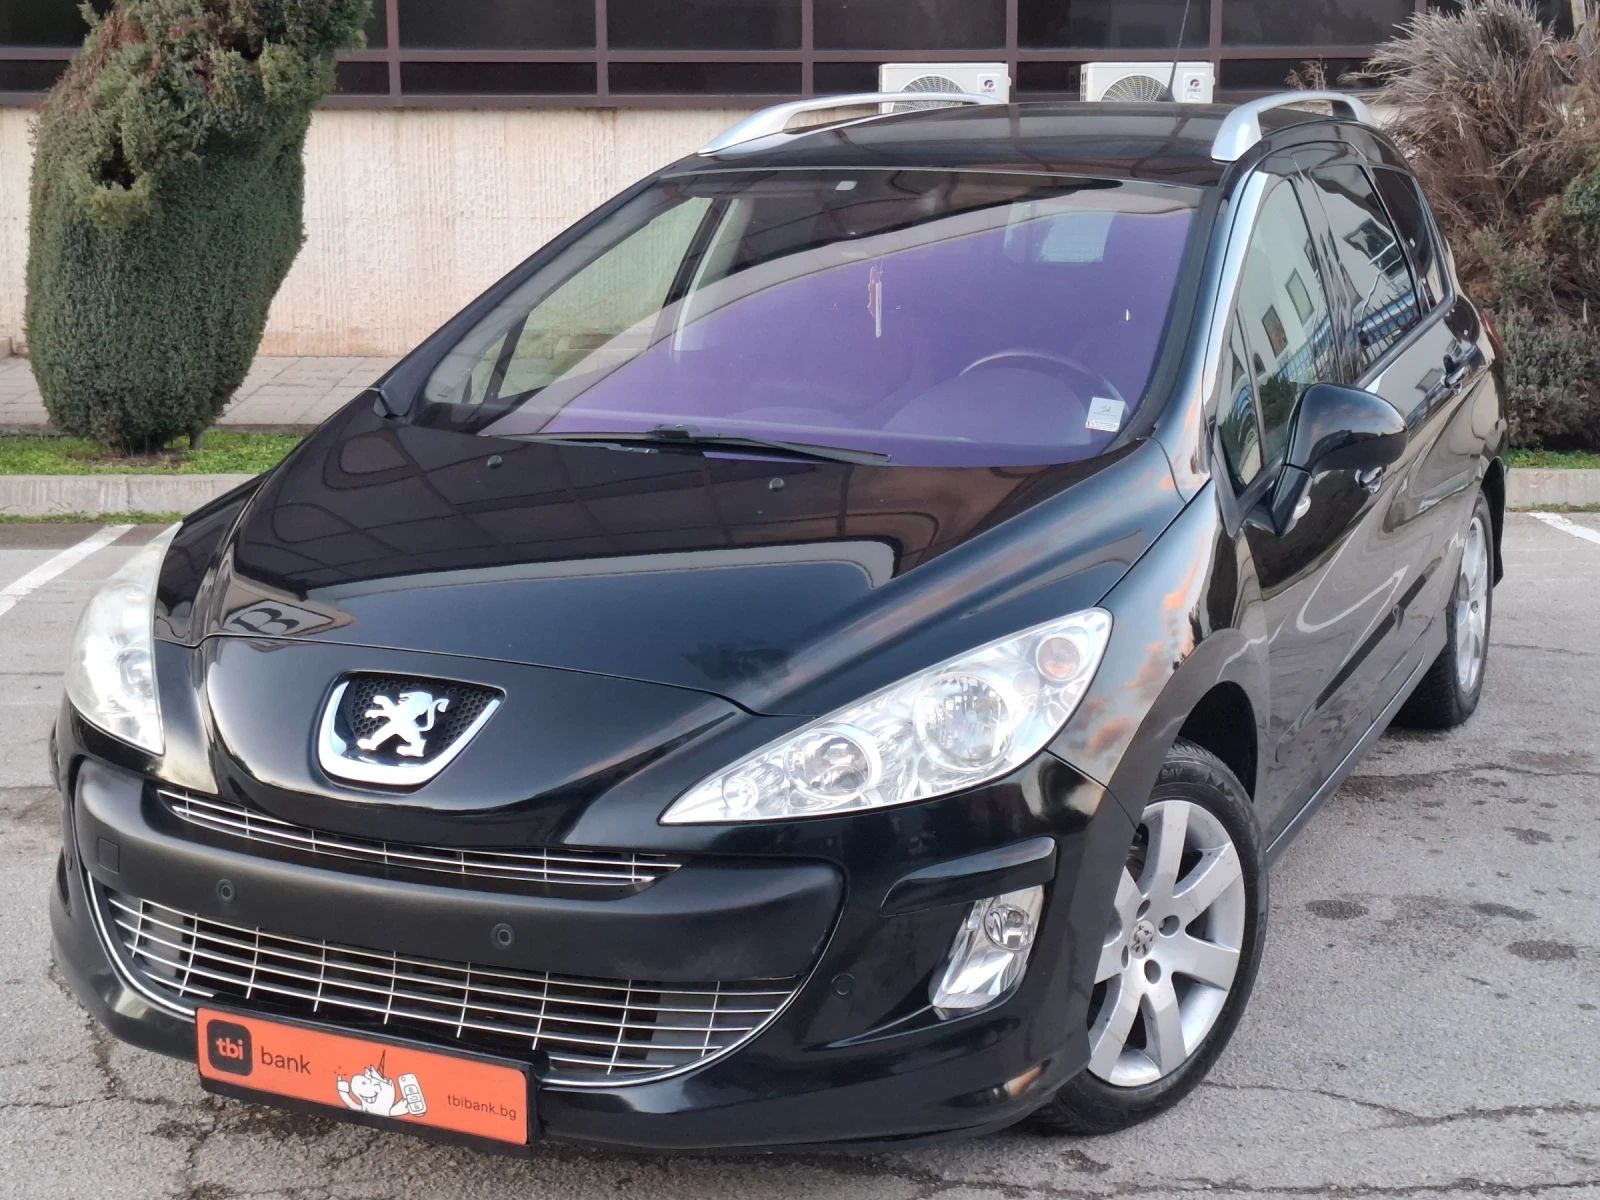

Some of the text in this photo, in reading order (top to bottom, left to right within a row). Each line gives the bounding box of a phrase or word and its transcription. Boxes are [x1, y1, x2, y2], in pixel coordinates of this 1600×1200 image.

[215, 1037, 312, 1075] tbi bank
[447, 1094, 517, 1121] tbibank.bg
